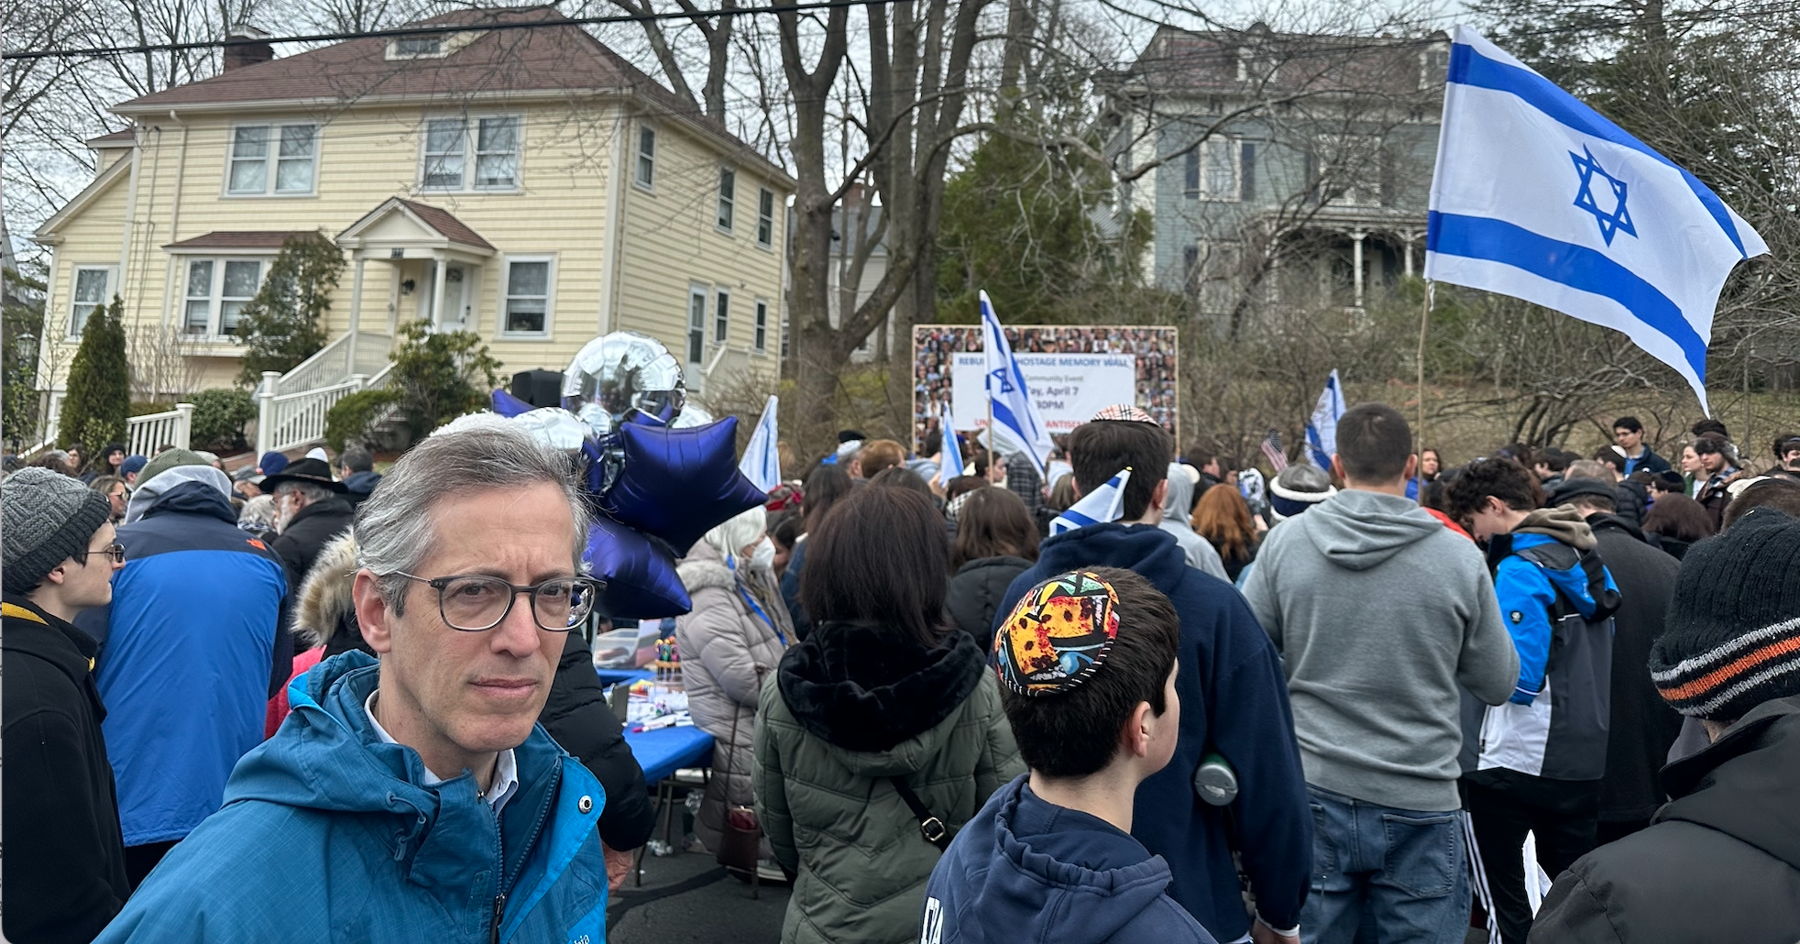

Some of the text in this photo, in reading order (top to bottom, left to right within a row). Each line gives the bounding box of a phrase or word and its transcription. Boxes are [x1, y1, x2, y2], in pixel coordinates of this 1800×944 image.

[1018, 357, 1057, 366] HOSTAGE
[1059, 358, 1101, 366] MEMORY
[1104, 358, 1128, 367] WALL
[1045, 386, 1071, 397] April
[1072, 386, 1079, 395] 7
